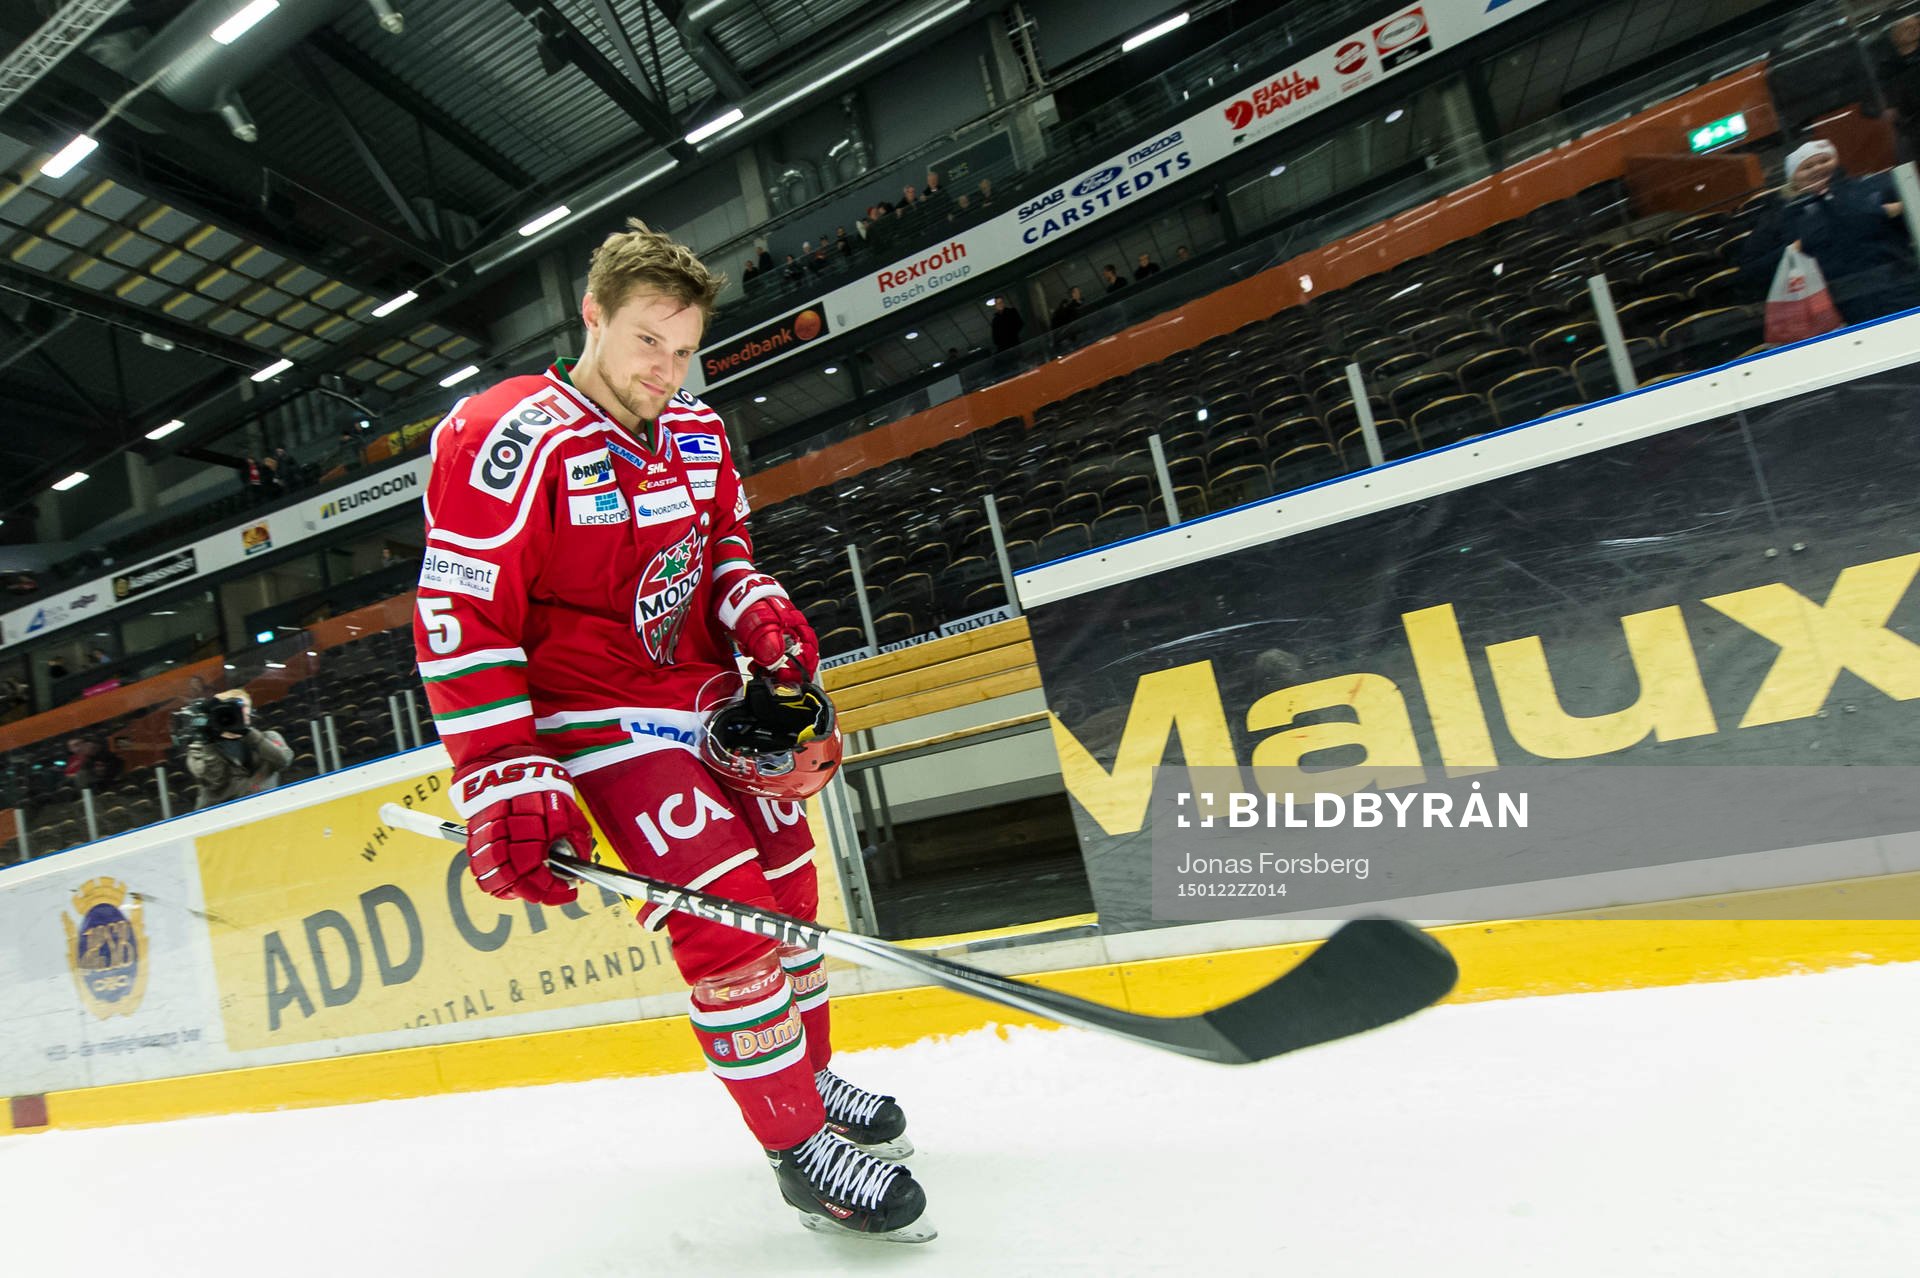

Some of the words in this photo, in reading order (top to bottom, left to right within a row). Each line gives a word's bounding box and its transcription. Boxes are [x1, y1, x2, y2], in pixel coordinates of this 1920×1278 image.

[1018, 188, 1064, 220] SAAB
[1022, 151, 1192, 244] CARSTEDTS
[877, 242, 966, 293] Rexroth
[882, 283, 925, 309] Bosch
[927, 264, 971, 289] Group
[705, 328, 792, 376] Swedbank
[647, 462, 667, 475] SHL
[337, 472, 418, 512] EUROCON
[424, 554, 493, 584] element
[638, 568, 702, 621] MODO
[417, 597, 462, 655] 5
[879, 631, 941, 654] VOLVIA
[943, 610, 1011, 635] VOLVIA
[1049, 553, 1920, 836] Malux
[635, 786, 735, 857] ICA
[648, 885, 820, 951] EASTON
[263, 884, 424, 1031] ADD
[509, 979, 524, 1003] &
[825, 1202, 847, 1216] CCM
